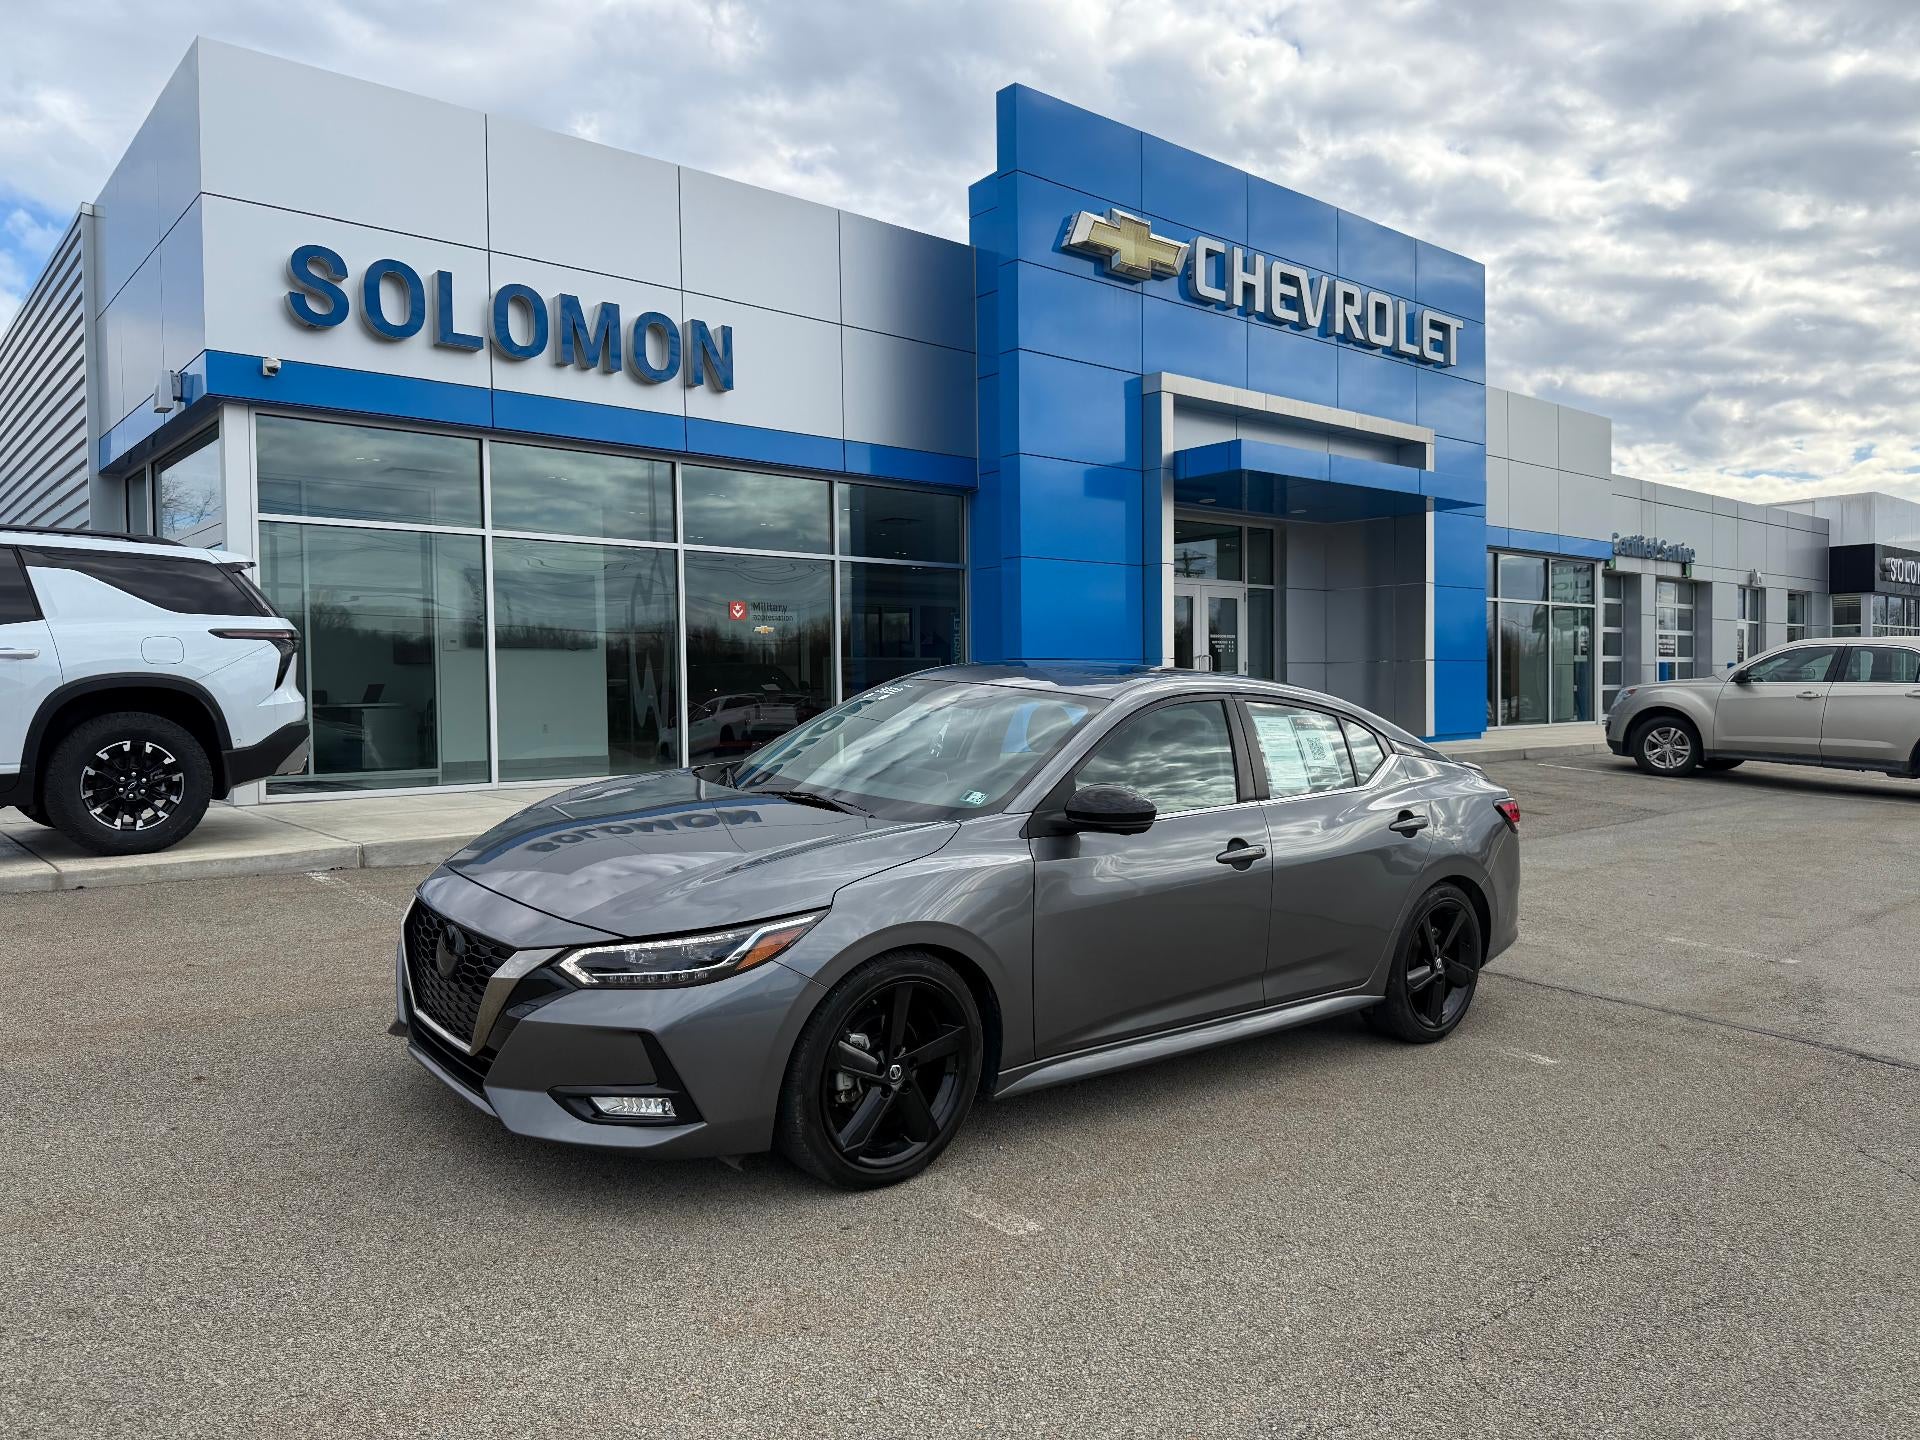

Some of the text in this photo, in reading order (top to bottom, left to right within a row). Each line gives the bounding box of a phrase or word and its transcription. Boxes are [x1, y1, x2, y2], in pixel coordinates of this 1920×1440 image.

[1191, 235, 1464, 368] CHEVROLET
[285, 244, 734, 392] SOLOMON
[1611, 532, 1696, 563] Certified Service
[1889, 557, 1920, 584] SOLO
[752, 601, 788, 615] Military
